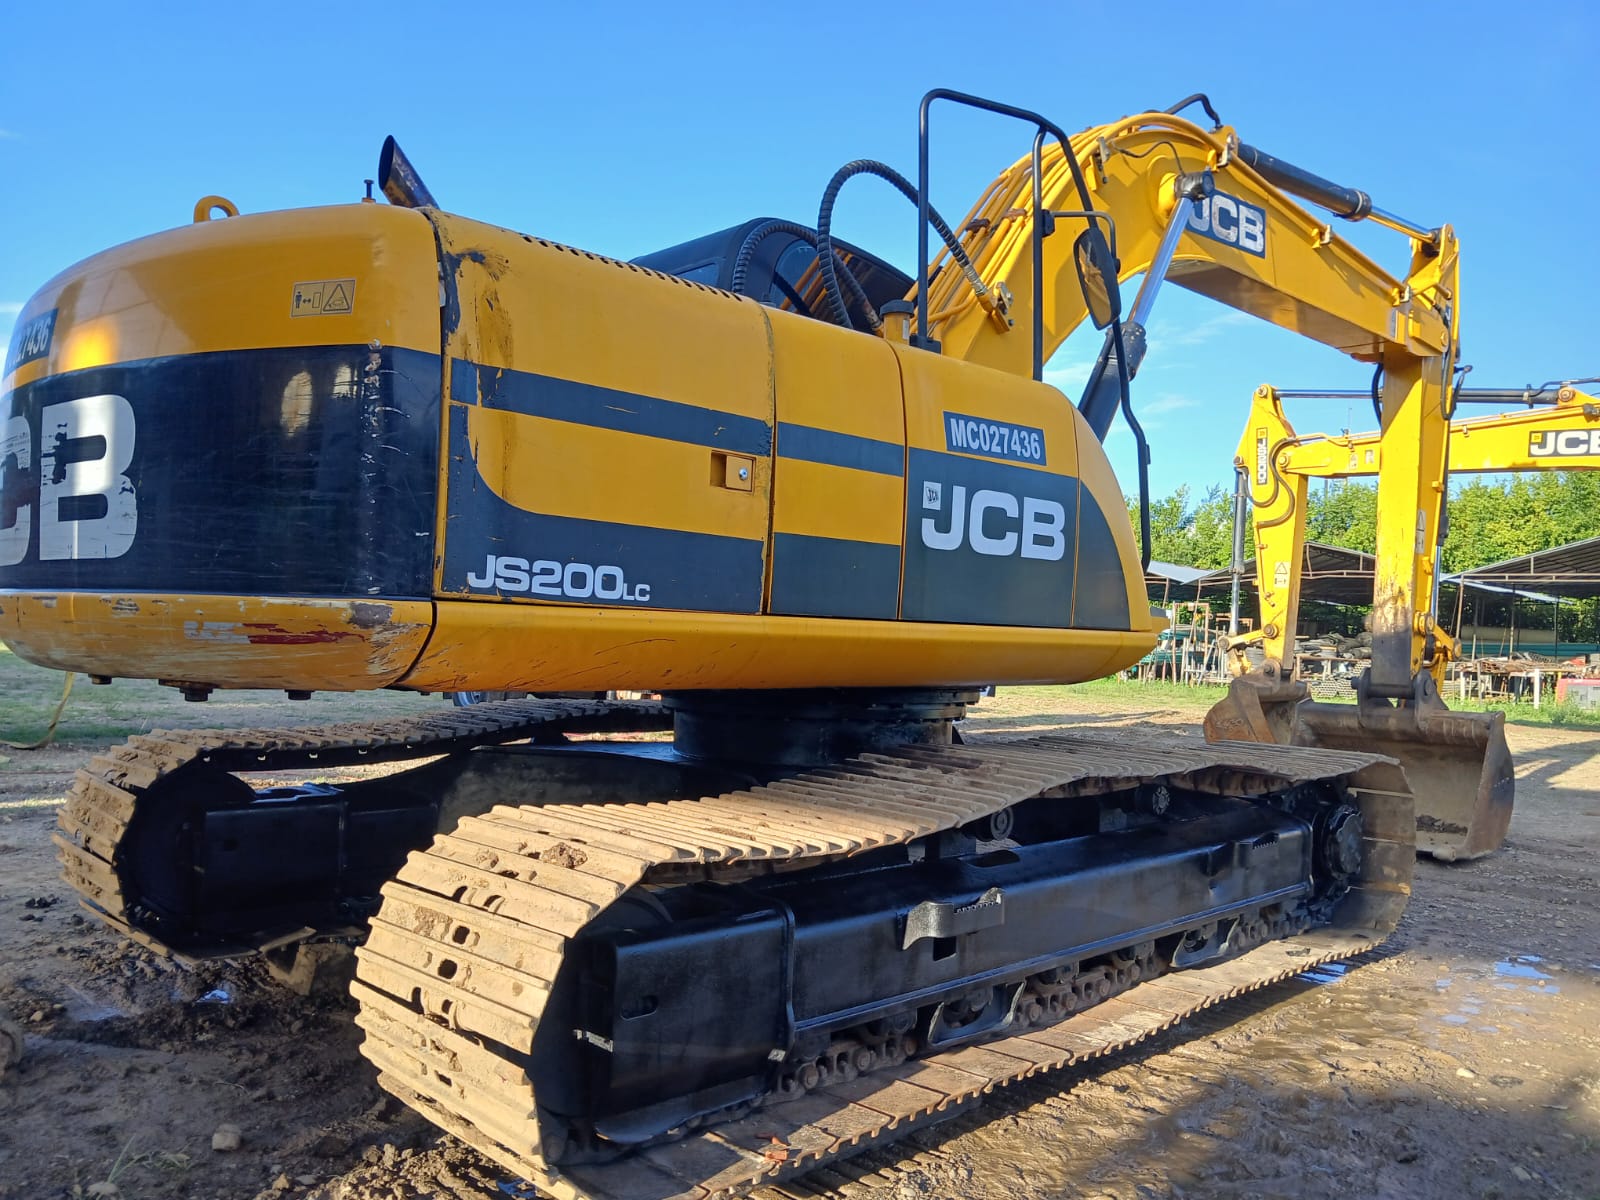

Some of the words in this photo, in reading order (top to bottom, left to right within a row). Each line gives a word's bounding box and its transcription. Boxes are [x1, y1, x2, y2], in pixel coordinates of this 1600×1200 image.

[1188, 194, 1264, 252] JCB
[950, 417, 1041, 460] MC027436
[921, 484, 1066, 561] JCB
